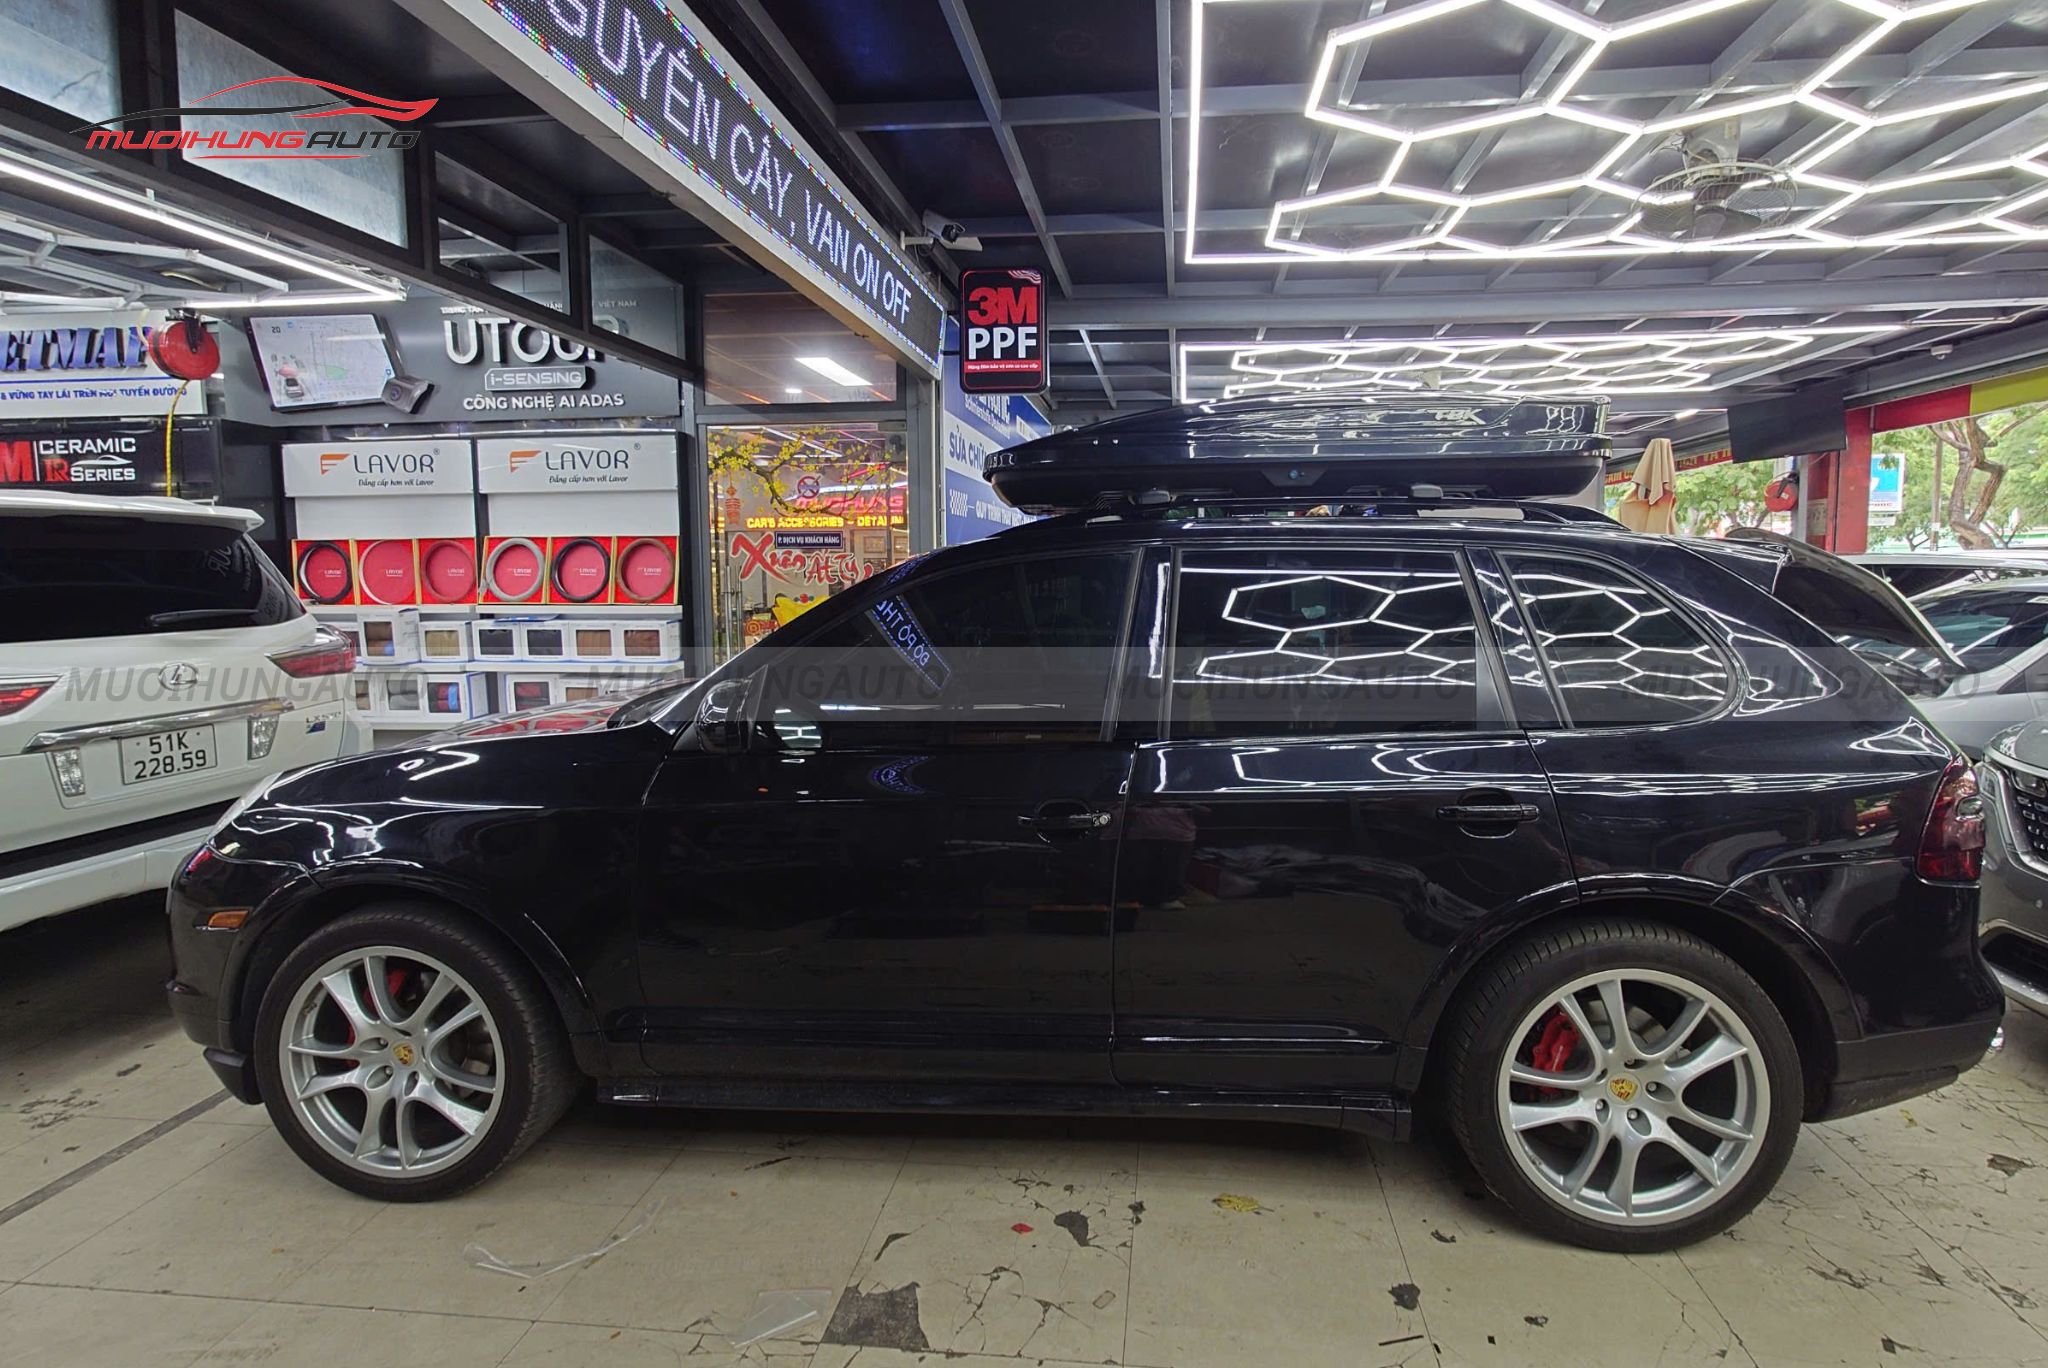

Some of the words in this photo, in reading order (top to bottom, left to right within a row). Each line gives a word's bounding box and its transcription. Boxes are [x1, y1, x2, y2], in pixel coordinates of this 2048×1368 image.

[805, 189, 850, 273] VAN
[853, 243, 880, 300] ON
[882, 270, 912, 324] OFF
[967, 286, 1038, 326] 3M
[967, 326, 1038, 360] PPF
[490, 371, 582, 387] i-SENSING
[37, 389, 54, 399] TAY
[56, 387, 71, 399] LÁI
[463, 393, 508, 410] CÔNG
[512, 393, 556, 412] NGHỆ
[559, 394, 576, 407] AI
[579, 393, 625, 407] ADAS
[39, 437, 137, 455] CERAMIC
[949, 425, 968, 465] SỬA
[968, 442, 986, 472] CHỮ
[353, 453, 435, 474] LAVOR
[545, 449, 629, 471] LAVOR
[358, 478, 376, 487] Đẳng
[377, 477, 389, 487] cấp
[390, 478, 403, 487] hơn
[415, 478, 435, 487] Lavor
[549, 475, 567, 484] Đẳng
[568, 475, 581, 484] cấp
[582, 475, 596, 483] hơn
[608, 474, 629, 483] Lavor
[805, 534, 824, 544] KHÁCH
[824, 534, 840, 544] HÀNG
[149, 731, 190, 755] 51K
[133, 749, 207, 780] 228.59
